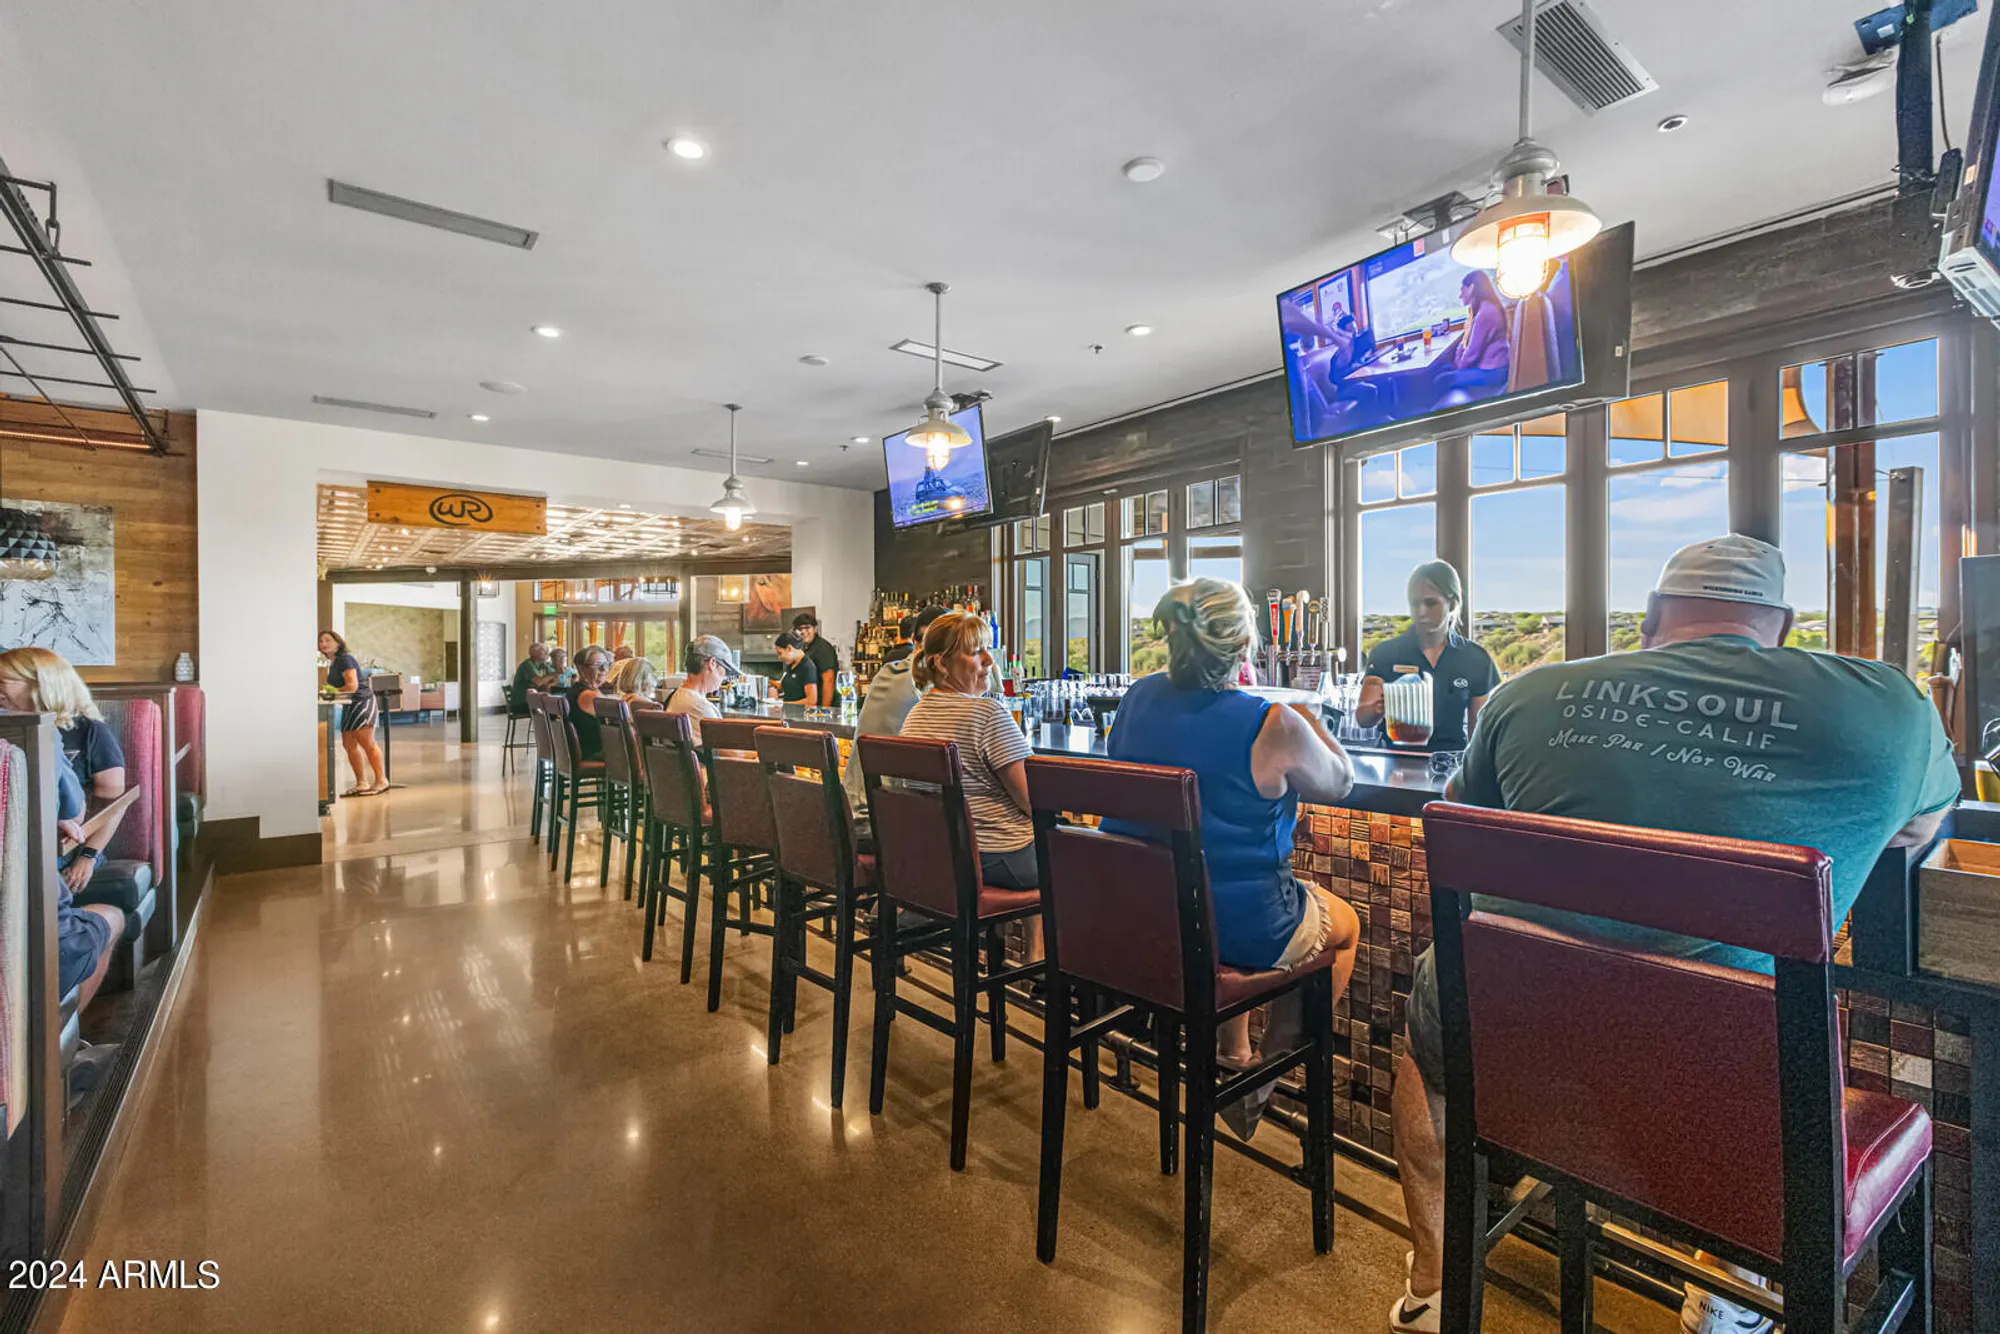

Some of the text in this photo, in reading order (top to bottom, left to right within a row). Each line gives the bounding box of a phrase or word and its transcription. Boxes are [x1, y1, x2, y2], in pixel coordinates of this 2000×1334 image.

[1556, 680, 1798, 731] LINKSOUL
[1563, 705, 1776, 750] OSIDE-CALIF
[1699, 1300, 1725, 1320] NIKE
